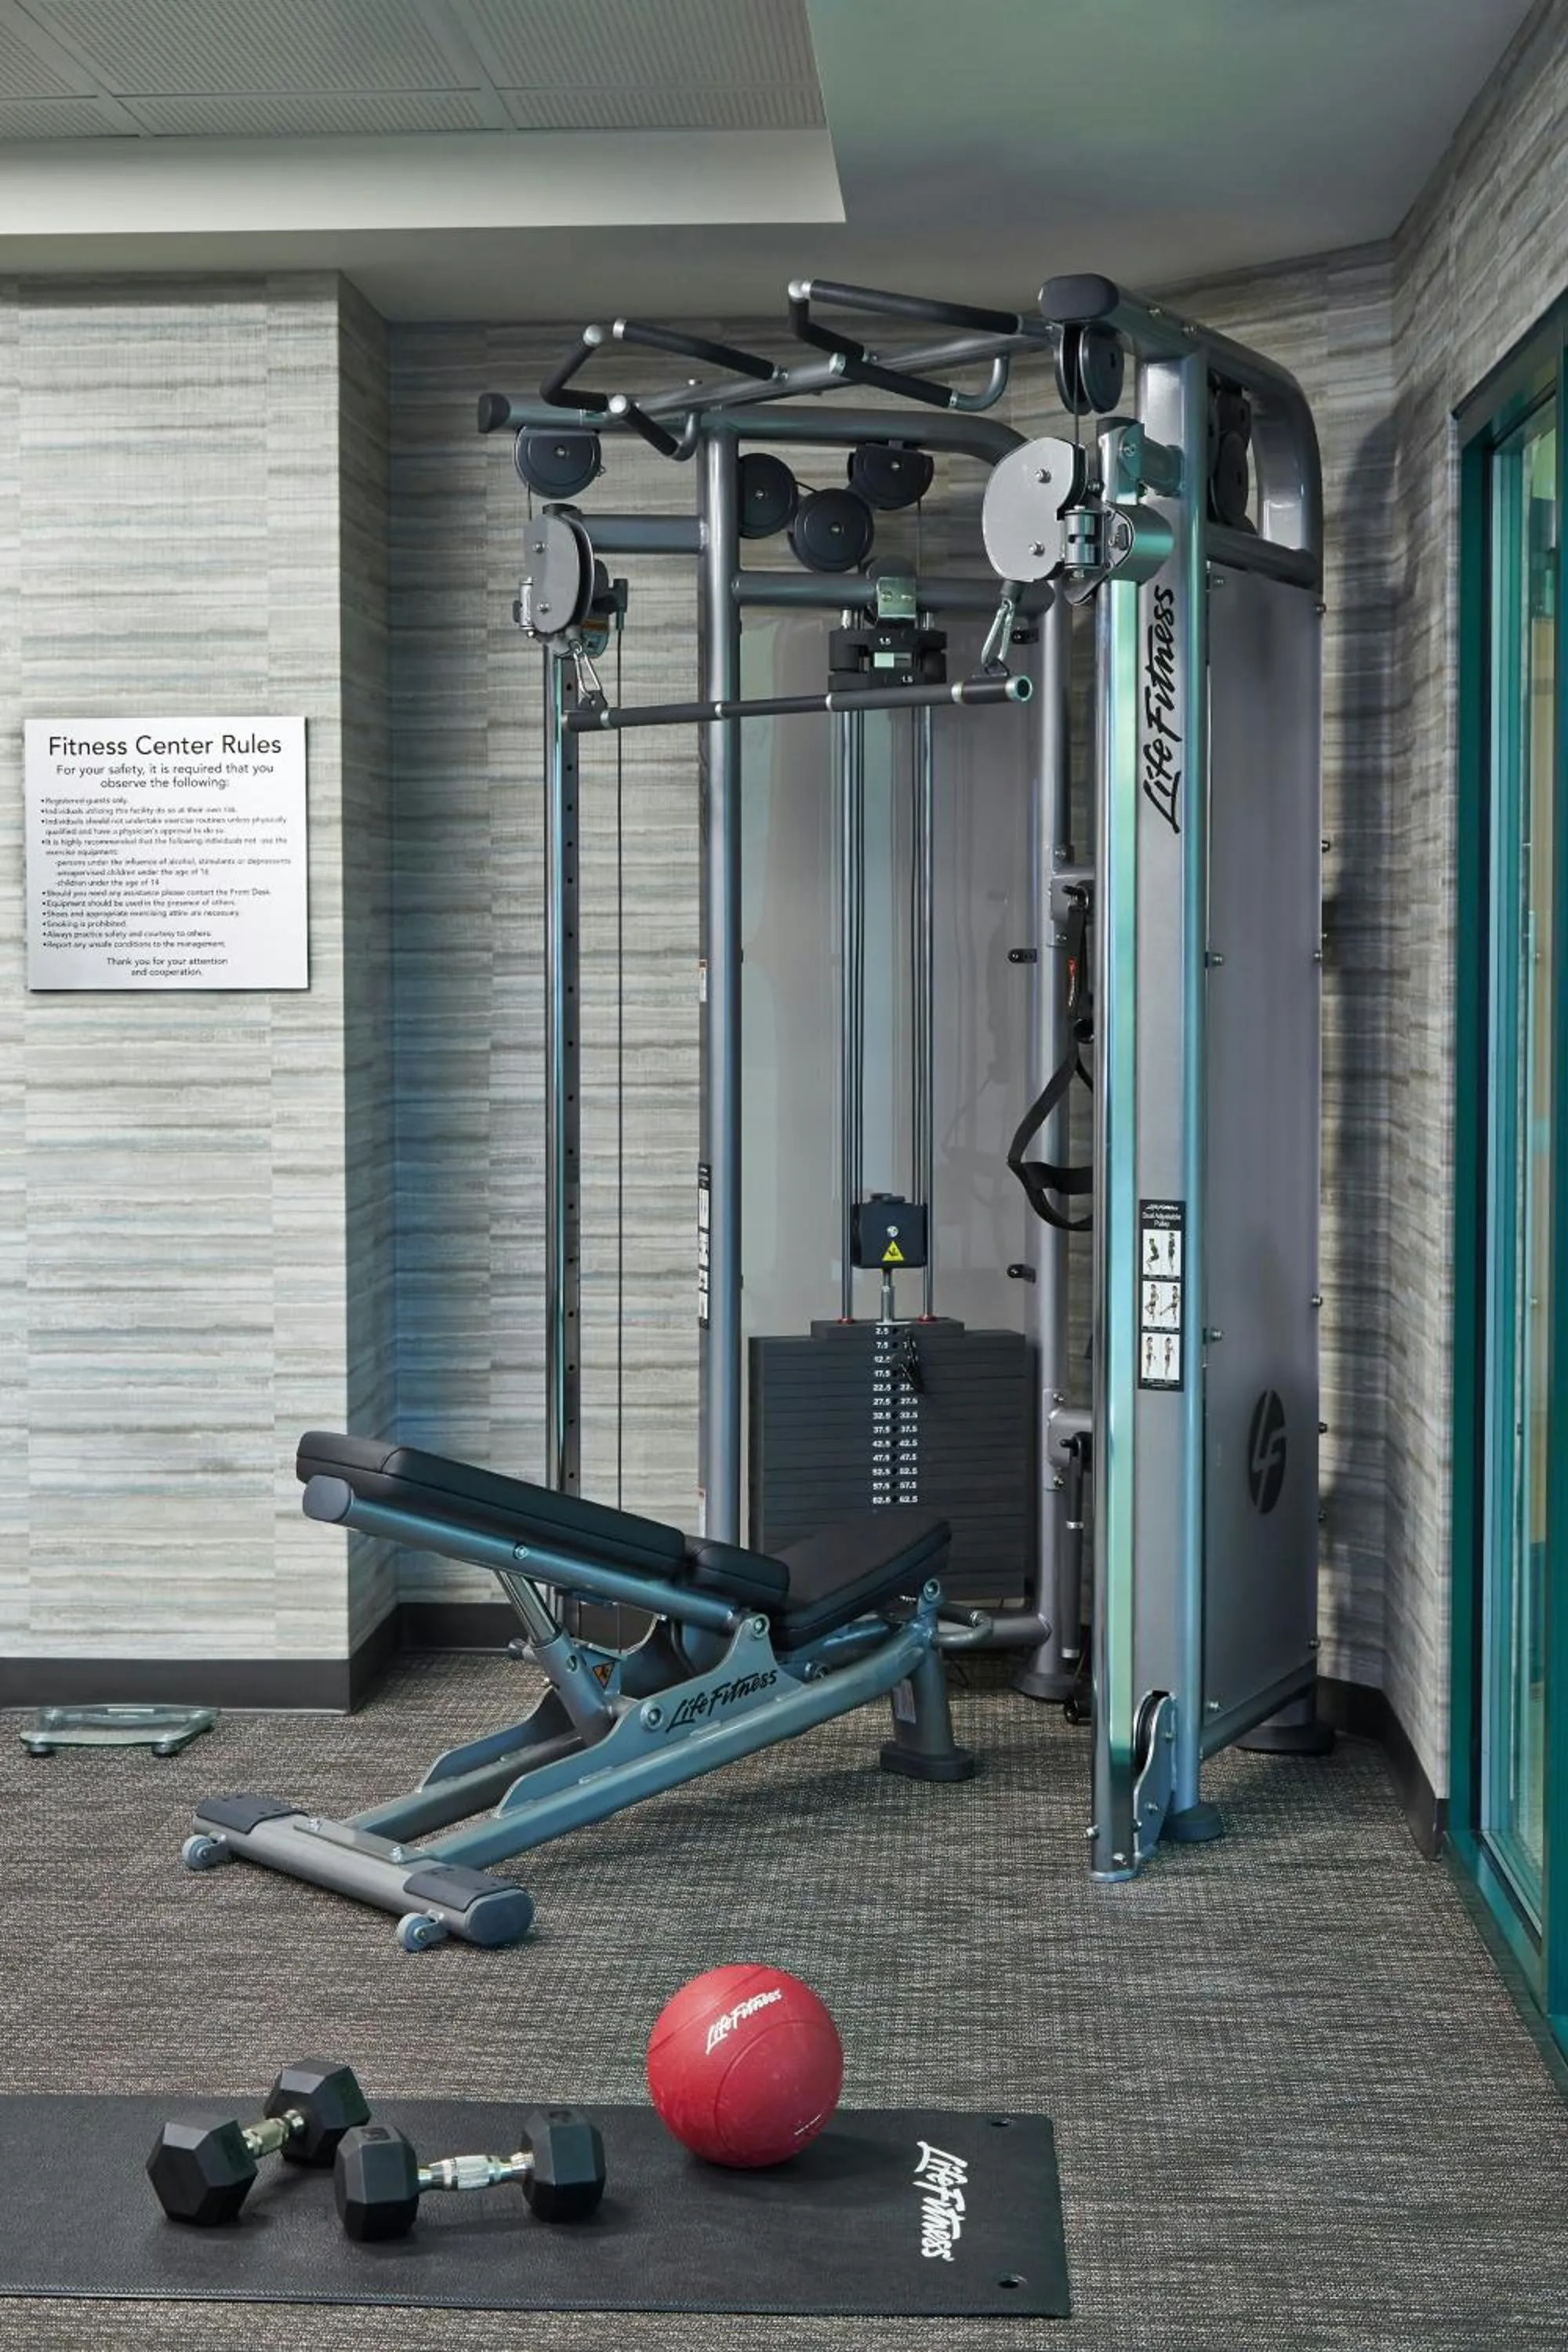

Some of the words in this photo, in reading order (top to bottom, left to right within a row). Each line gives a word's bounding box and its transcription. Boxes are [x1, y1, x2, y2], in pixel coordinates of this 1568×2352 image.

[49, 736, 128, 756] Fitness
[136, 735, 213, 755] Center
[222, 733, 281, 753] Rules
[56, 764, 75, 775] For
[79, 766, 104, 778] your
[108, 763, 145, 776] safety,
[149, 763, 156, 773] it
[161, 763, 169, 773] is
[173, 762, 222, 775] required
[226, 762, 249, 773] that
[252, 764, 274, 775] you
[100, 778, 147, 788] observe
[151, 777, 169, 787] the
[172, 776, 229, 790] following:
[107, 956, 132, 965] Thank
[153, 956, 165, 965] for
[190, 956, 229, 965] attention
